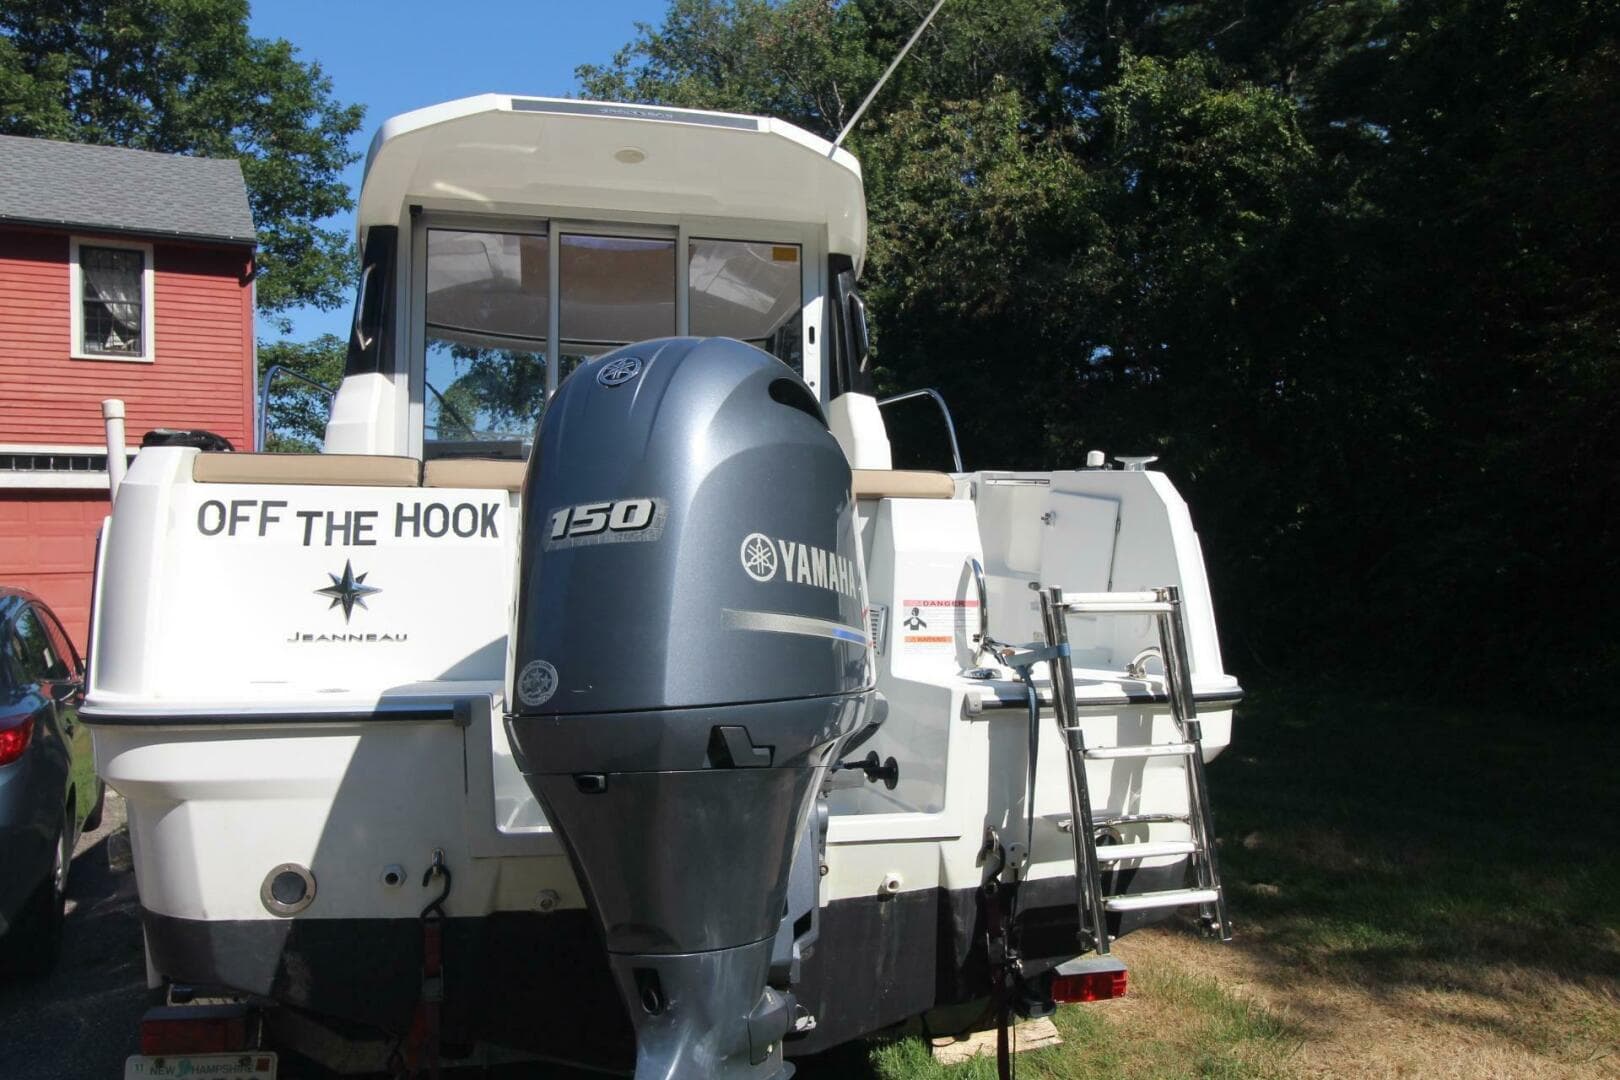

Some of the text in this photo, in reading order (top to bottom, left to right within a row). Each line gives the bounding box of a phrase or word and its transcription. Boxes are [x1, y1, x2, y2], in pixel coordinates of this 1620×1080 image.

[197, 499, 501, 547] OFF THE HOOK
[551, 499, 655, 540] 150
[778, 539, 857, 600] YAMAHA
[286, 631, 409, 643] JEANNEAU
[150, 1066, 176, 1076] NEW
[191, 1063, 254, 1074] HAMPSHIRE
